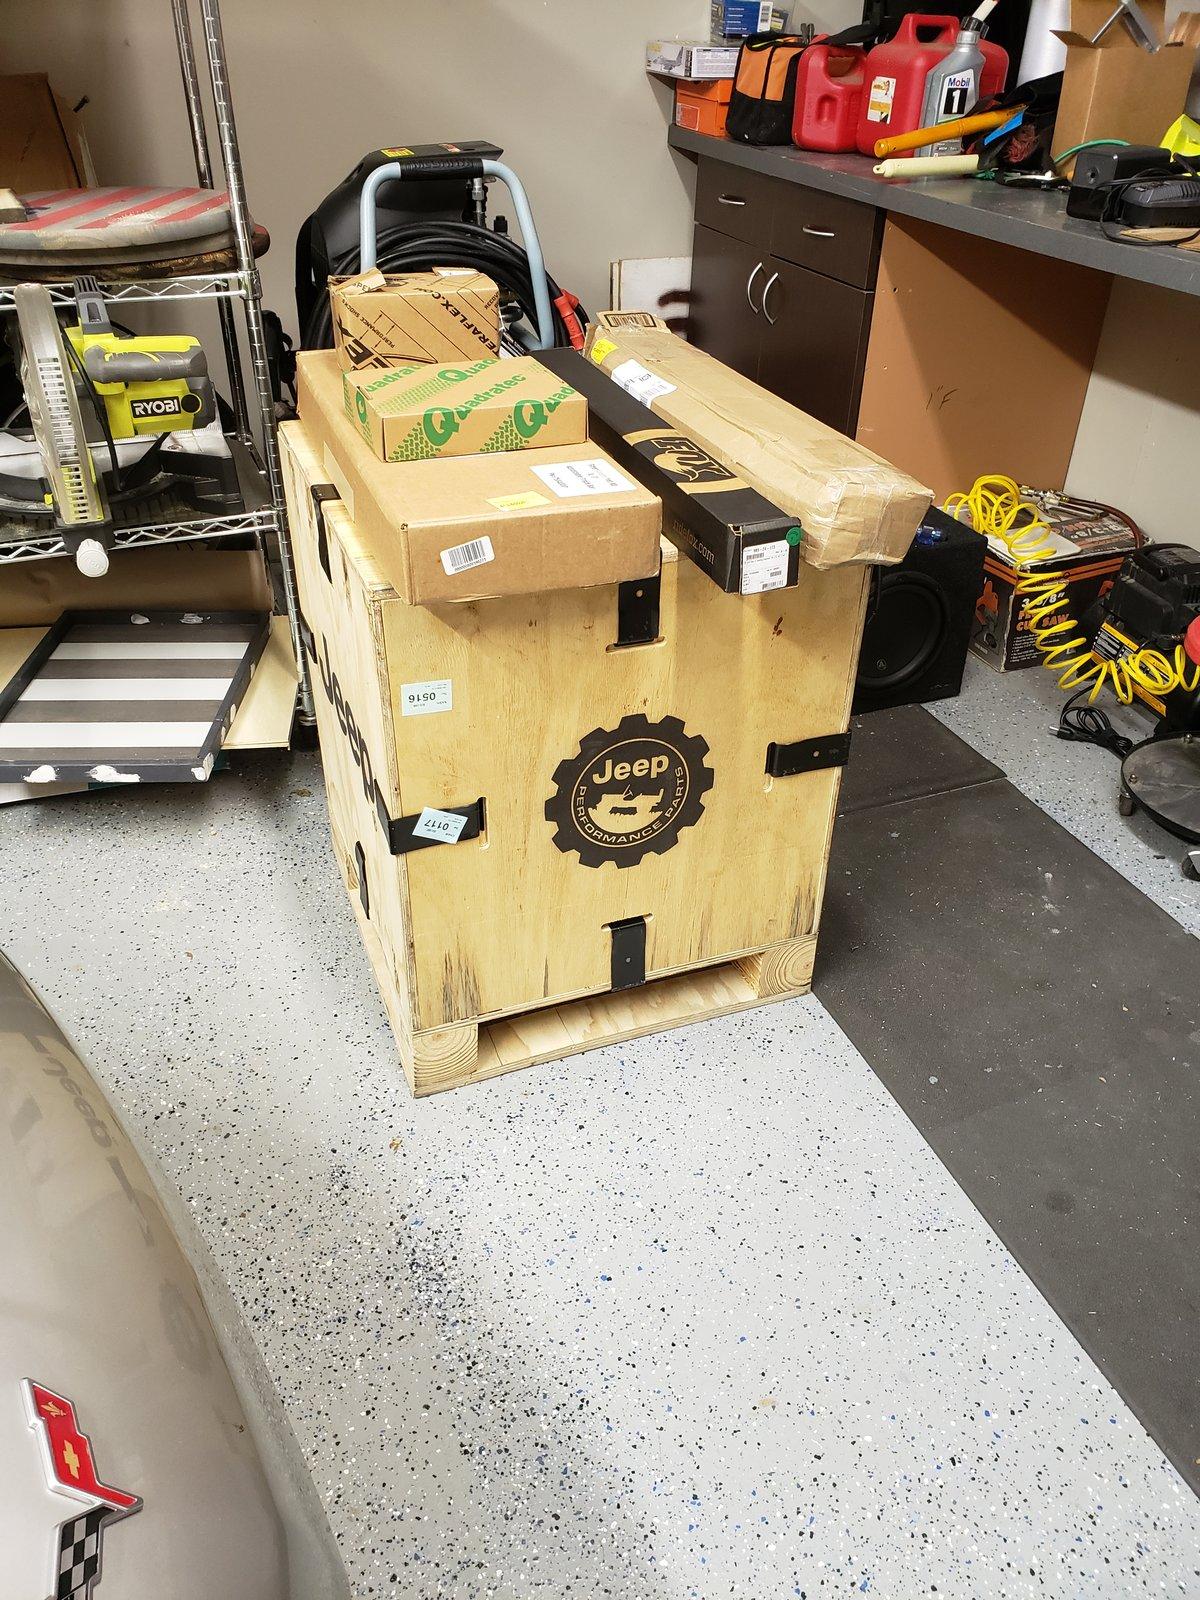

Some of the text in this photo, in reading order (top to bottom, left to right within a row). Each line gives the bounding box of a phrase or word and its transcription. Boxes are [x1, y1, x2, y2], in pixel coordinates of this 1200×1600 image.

[948, 77, 971, 88] Mobil
[951, 88, 961, 114] 1
[360, 316, 396, 349] PERFORMANCE
[132, 399, 179, 416] RYOBI
[423, 374, 526, 446] Quadratec
[650, 439, 732, 481] FOX
[672, 520, 715, 565] ridefox.com
[1041, 613, 1070, 628] SAW
[408, 692, 436, 704] 0516
[318, 631, 375, 804] Jeep
[592, 754, 669, 785] Jeep
[576, 766, 685, 844] PERFORMANCE PARTS
[424, 818, 449, 831] 0117
